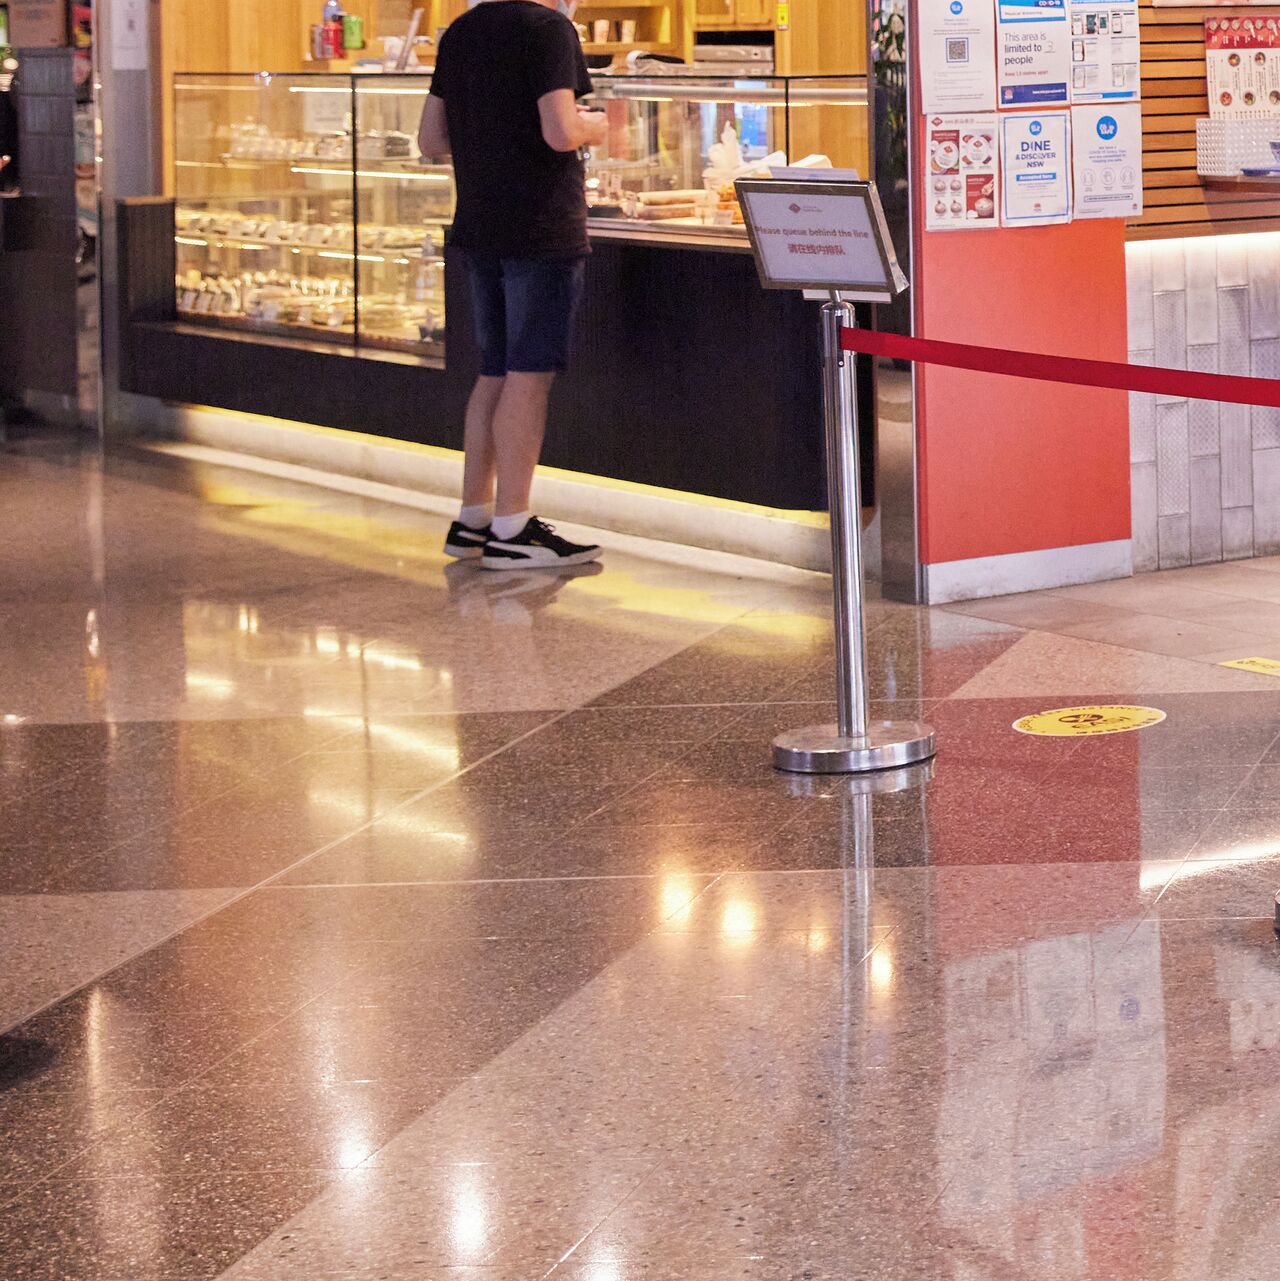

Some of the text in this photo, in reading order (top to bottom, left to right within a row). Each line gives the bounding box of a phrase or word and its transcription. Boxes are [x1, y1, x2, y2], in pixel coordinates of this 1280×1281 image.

[1004, 33, 1019, 41] This
[1004, 44, 1042, 53] limited to
[1004, 55, 1033, 66] people
[1021, 140, 1051, 151] DINE
[1021, 152, 1056, 160] DISCOVER
[755, 225, 780, 235] Please
[782, 228, 807, 237] queue
[809, 228, 836, 237] behind
[853, 230, 869, 238] line
